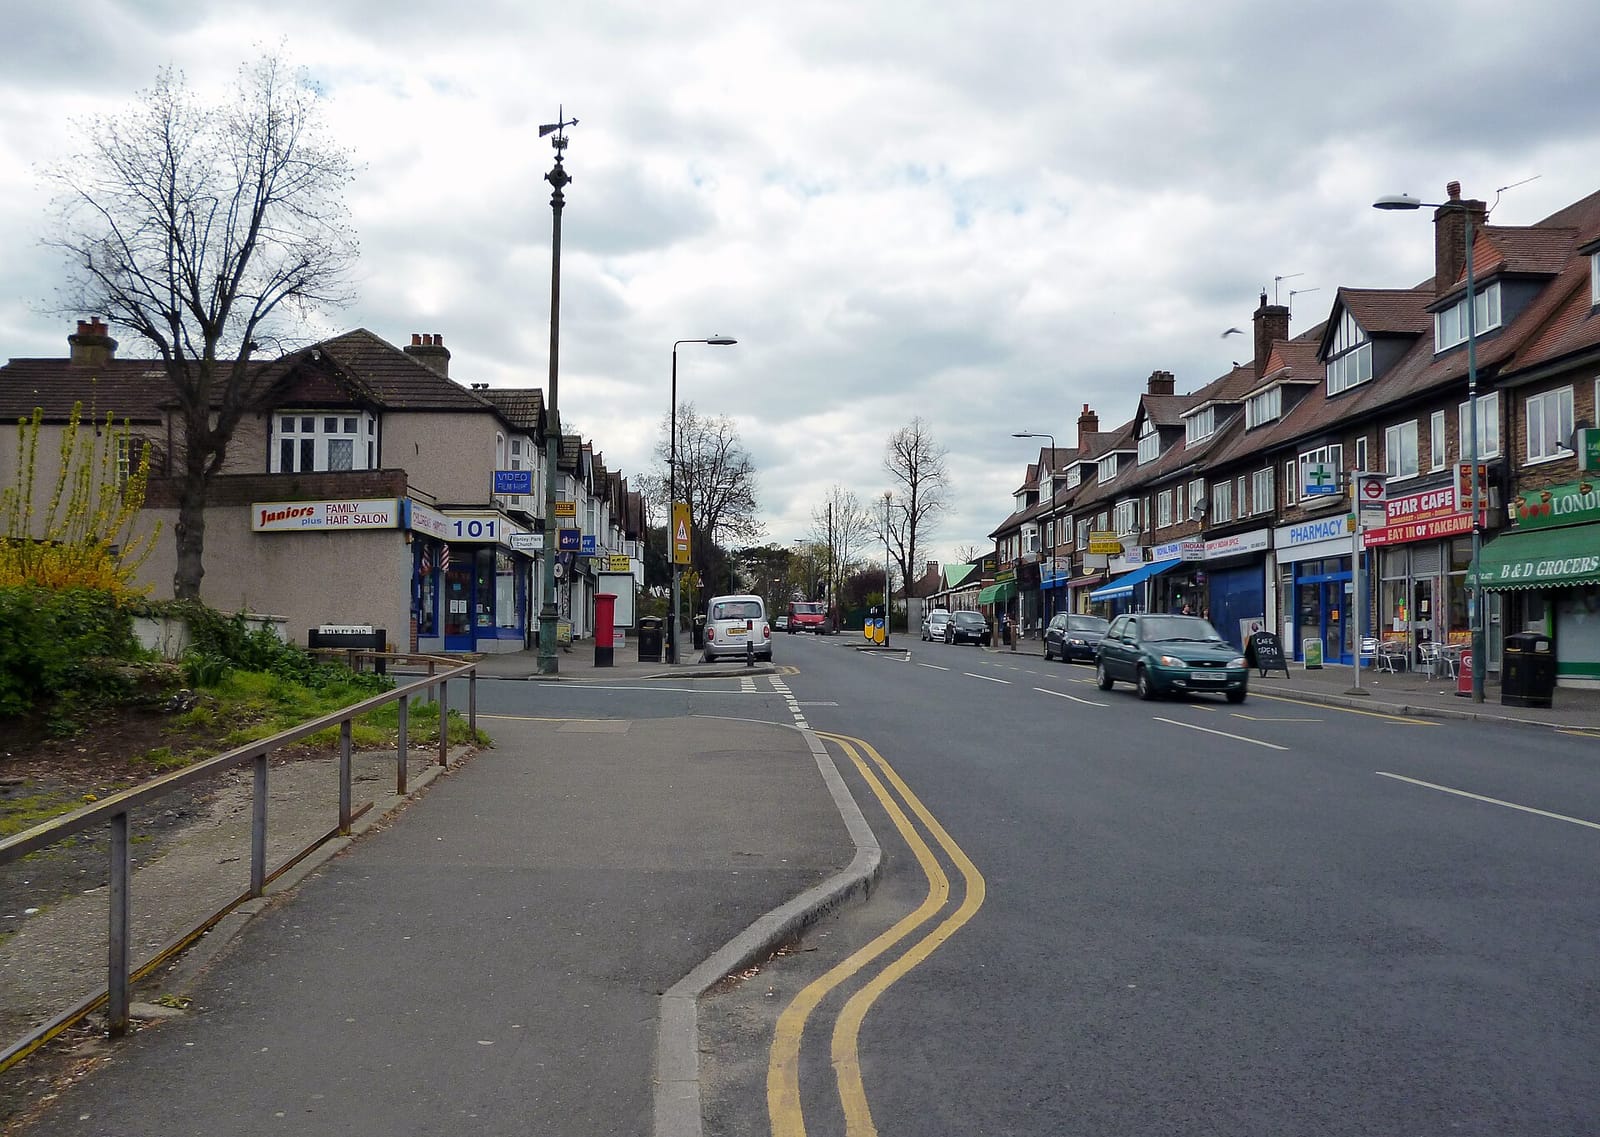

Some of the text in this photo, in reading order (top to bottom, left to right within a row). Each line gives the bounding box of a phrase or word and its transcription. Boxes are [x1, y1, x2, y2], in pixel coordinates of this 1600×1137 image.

[497, 473, 528, 481] VIDEO
[326, 503, 359, 514] FAMILY
[1388, 490, 1453, 518] STAR CAFE
[260, 506, 315, 527] Juniors
[301, 517, 322, 526] plus
[326, 513, 388, 525] HAIR SALON
[453, 520, 496, 537] 101
[1290, 519, 1343, 544] PHARMACY
[1387, 526, 1404, 541] EAT
[1405, 525, 1416, 538] IN
[1428, 514, 1475, 536] TAKEAWA
[1501, 565, 1511, 578] B
[1511, 564, 1521, 578] &
[1523, 563, 1534, 577] D
[1536, 556, 1599, 576] GROCERS
[1258, 647, 1278, 656] OPEN
